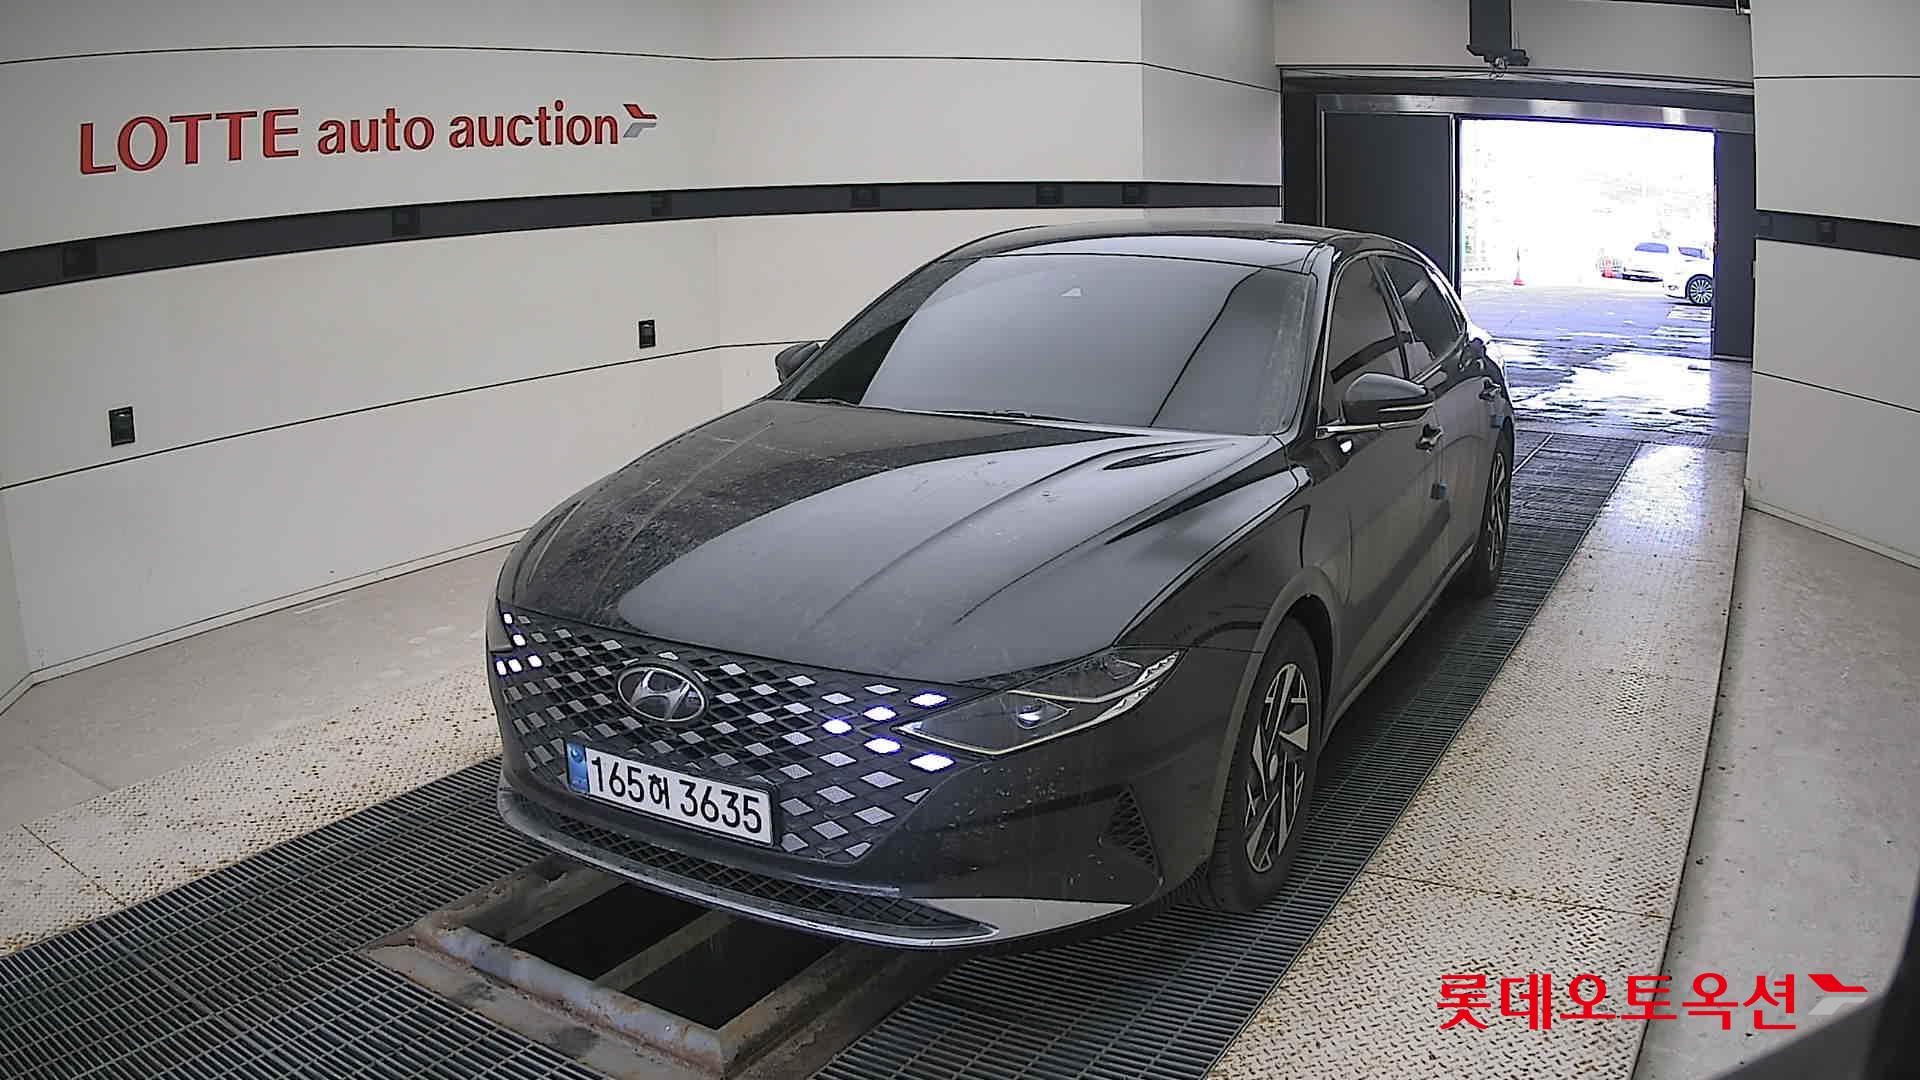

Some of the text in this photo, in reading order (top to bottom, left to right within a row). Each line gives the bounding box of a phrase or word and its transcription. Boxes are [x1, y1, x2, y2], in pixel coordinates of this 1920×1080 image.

[80, 100, 618, 175] LOTTE auto auction
[591, 756, 762, 834] 165허 3635
